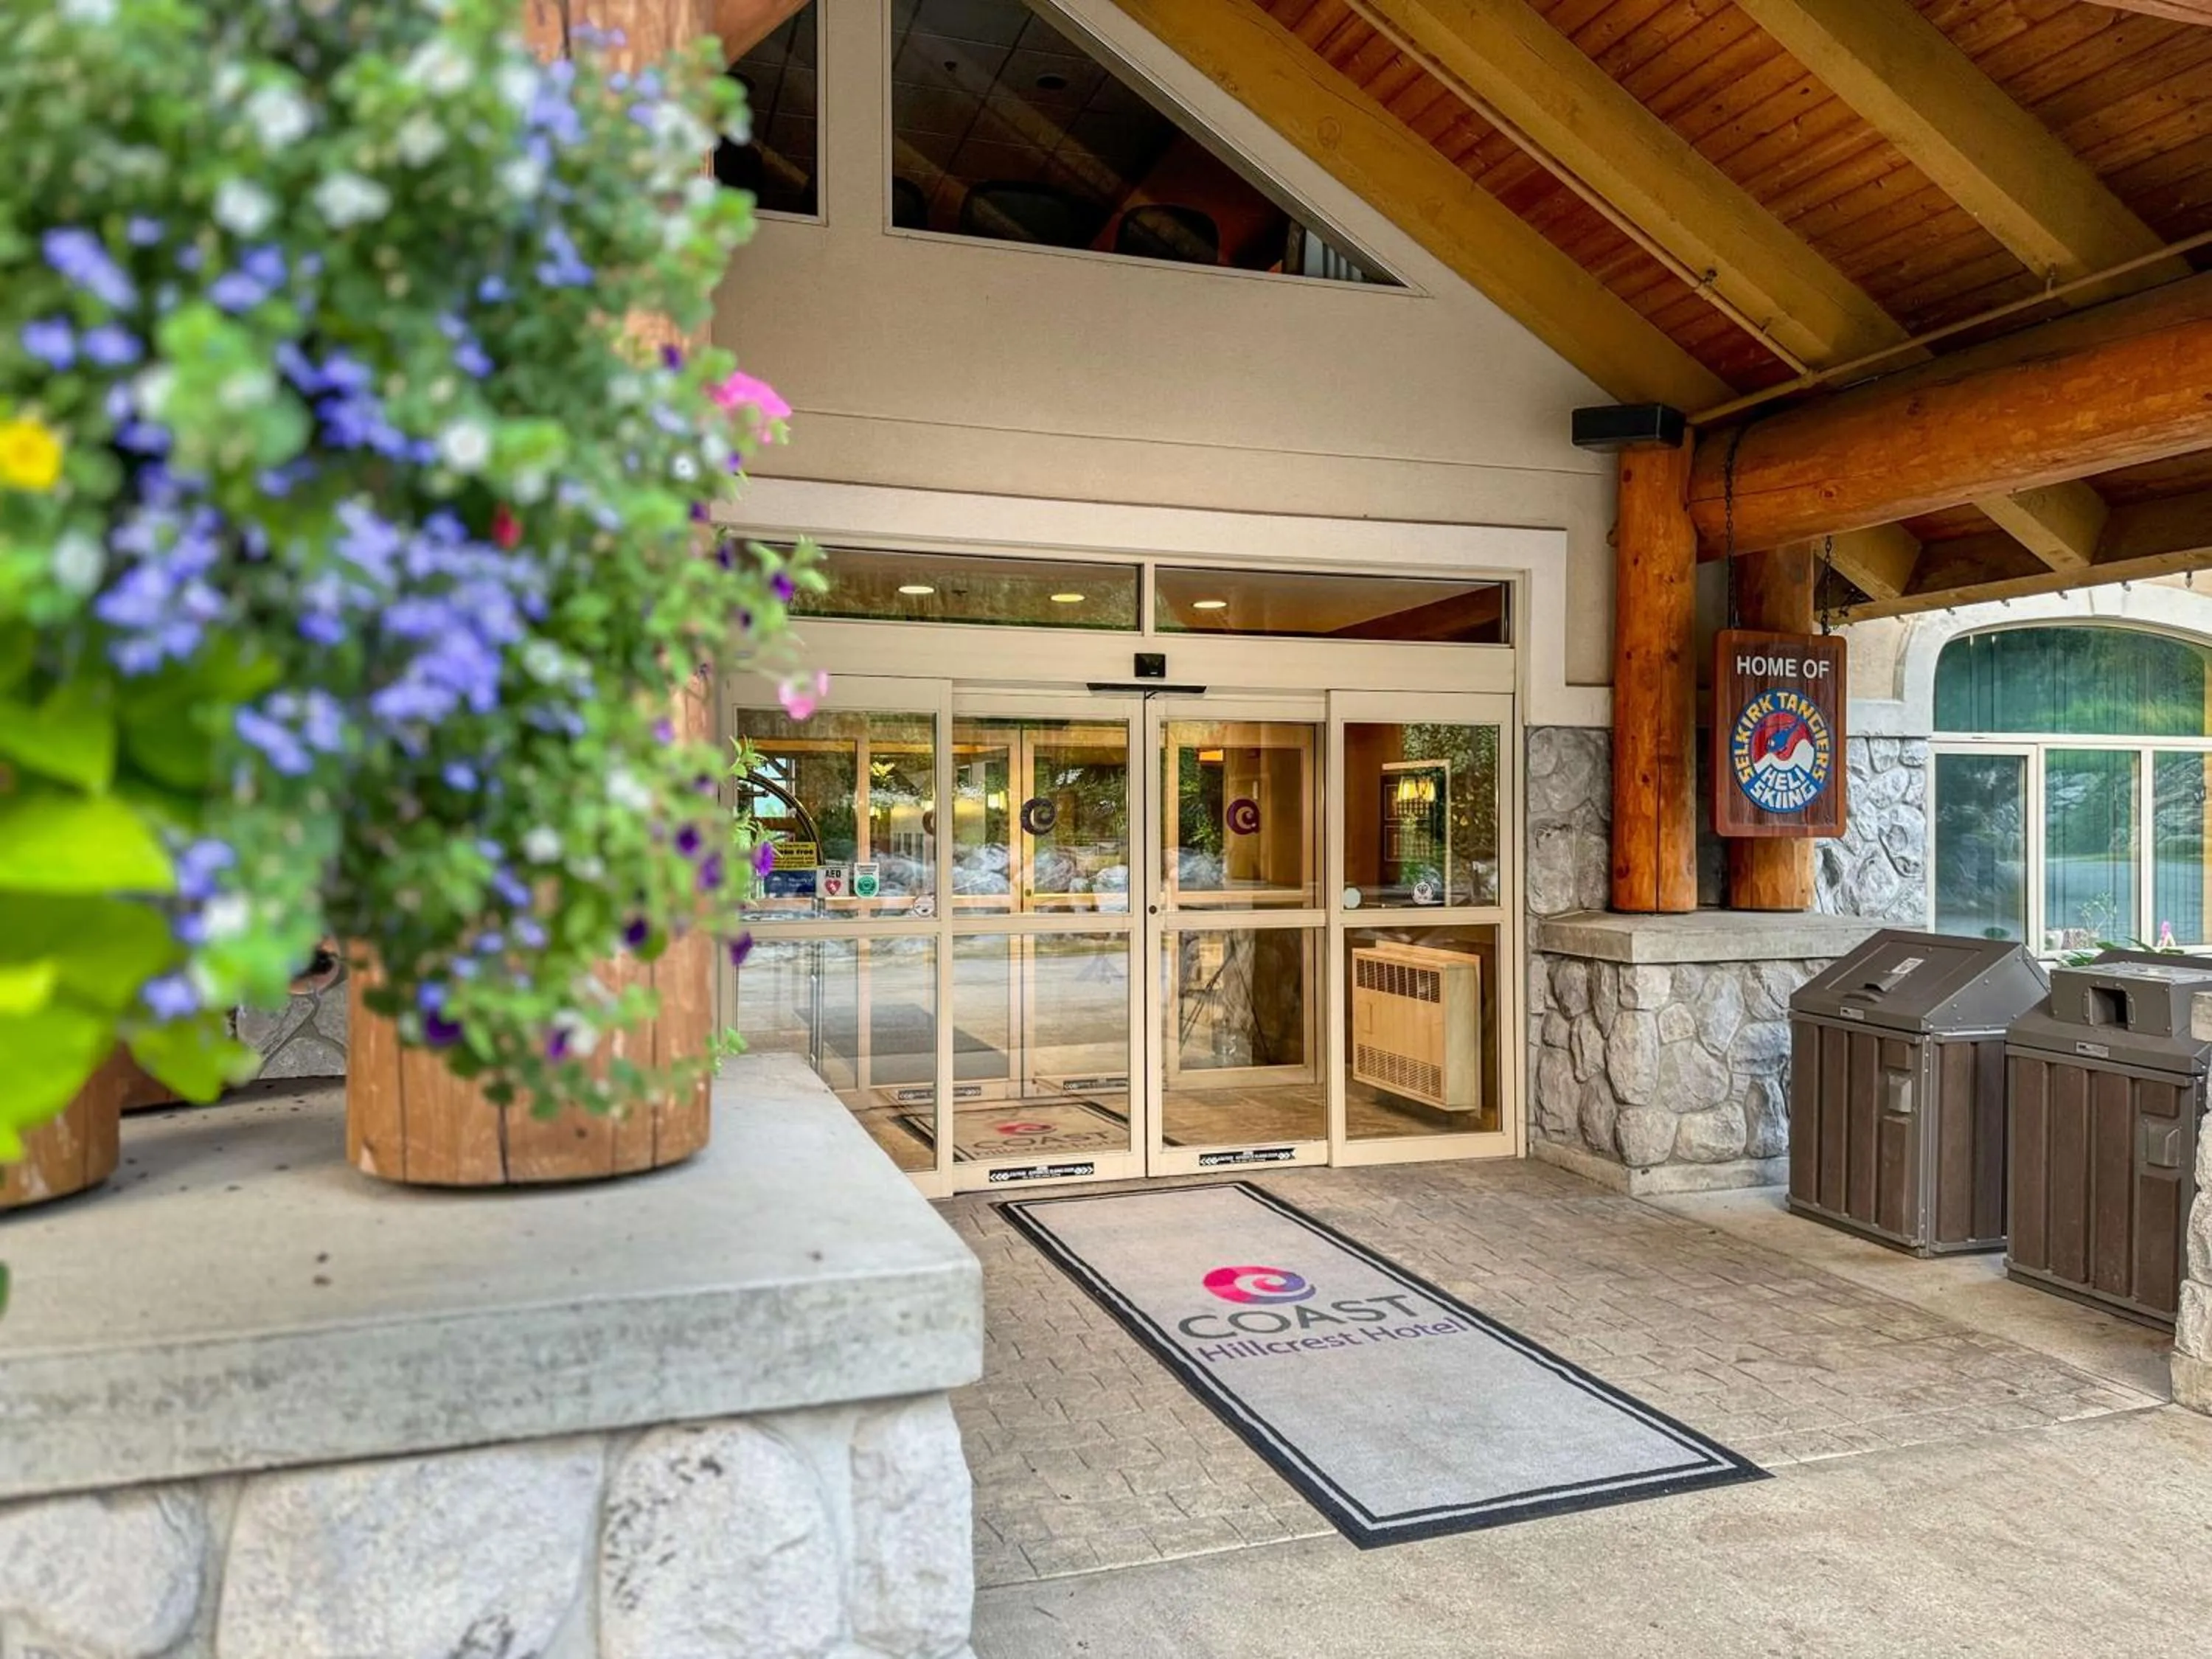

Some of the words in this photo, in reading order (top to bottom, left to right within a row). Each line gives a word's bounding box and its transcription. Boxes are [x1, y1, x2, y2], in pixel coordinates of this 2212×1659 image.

[1736, 655, 1797, 678] HOME
[1803, 659, 1830, 679] OF
[1733, 694, 1774, 785] SELKIRK
[1777, 692, 1830, 784] TANGIERS
[1761, 766, 1806, 791] HELI
[1749, 782, 1818, 809] SKIING
[825, 869, 841, 877] AED
[973, 1130, 1109, 1149] COAST
[1178, 1293, 1418, 1340] COAST
[1196, 1330, 1358, 1363] Hillcrest
[1359, 1318, 1470, 1343] Hotel
